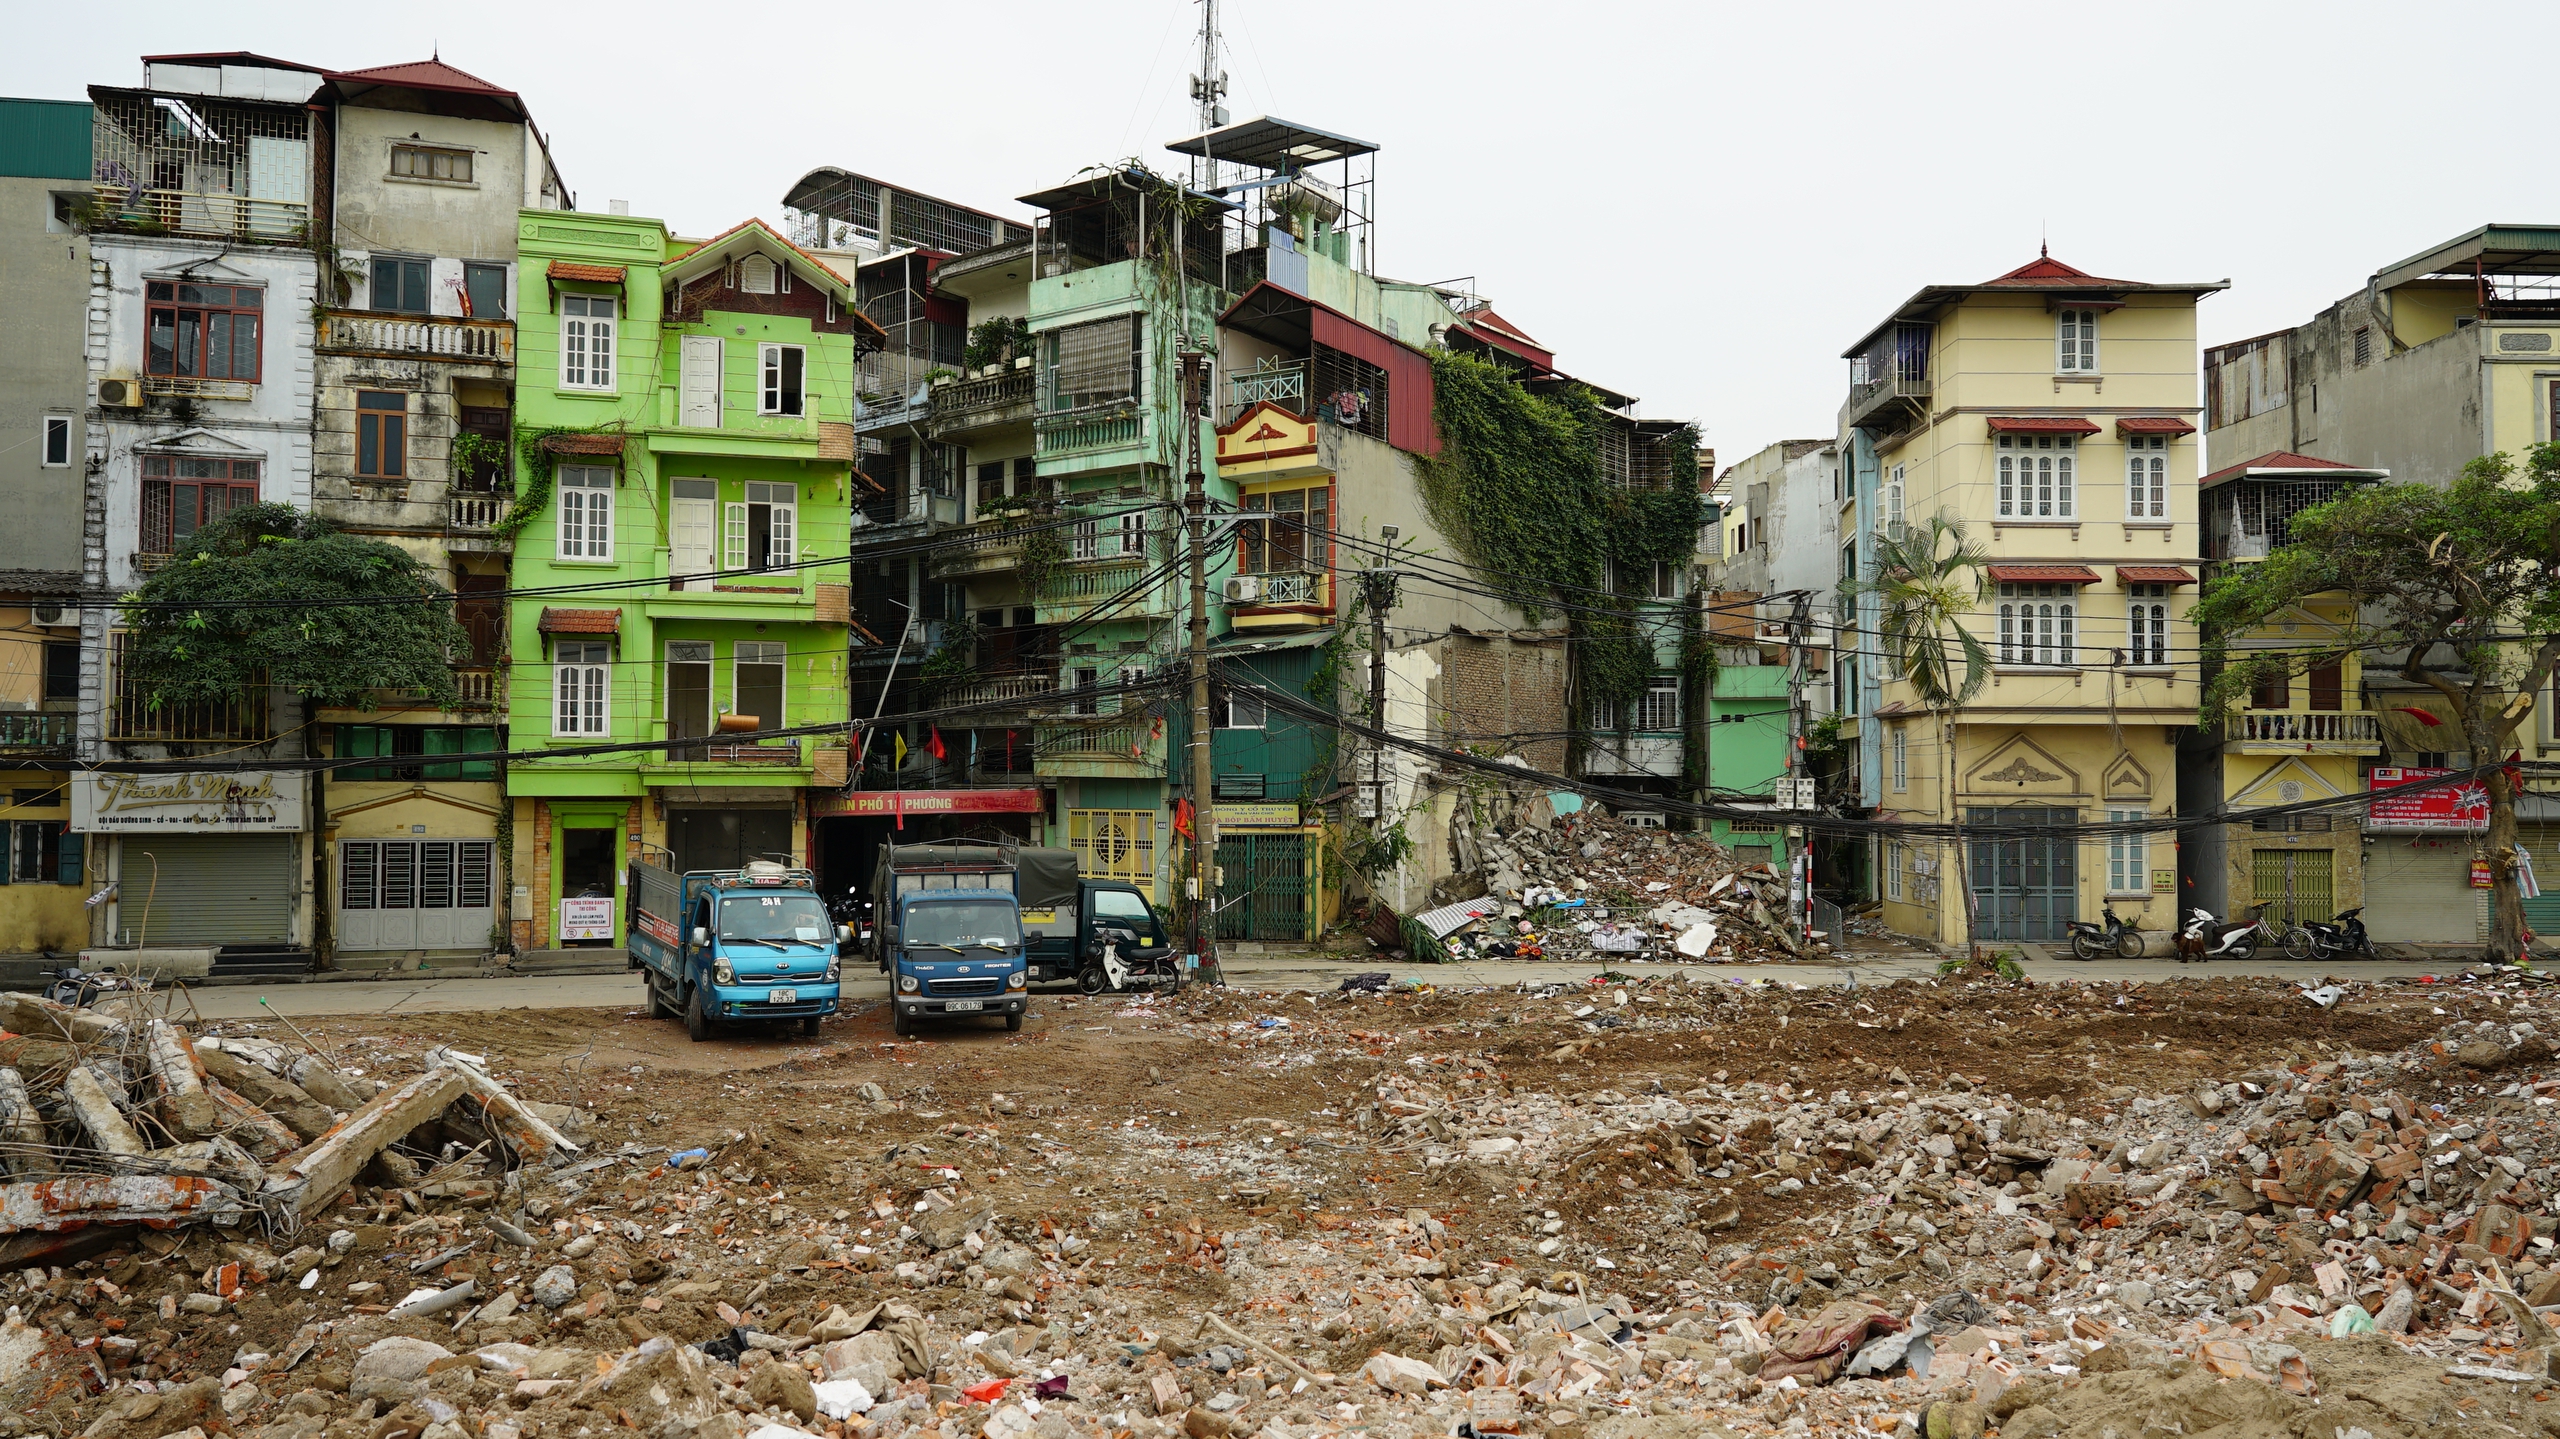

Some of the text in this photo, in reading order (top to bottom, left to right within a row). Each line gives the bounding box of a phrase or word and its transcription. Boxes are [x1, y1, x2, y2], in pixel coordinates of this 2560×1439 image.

[97, 771, 277, 812] Thanh Minh
[859, 795, 884, 811] PHỐ
[905, 796, 952, 809] PHƯỜNG
[761, 897, 781, 905] 24 H
